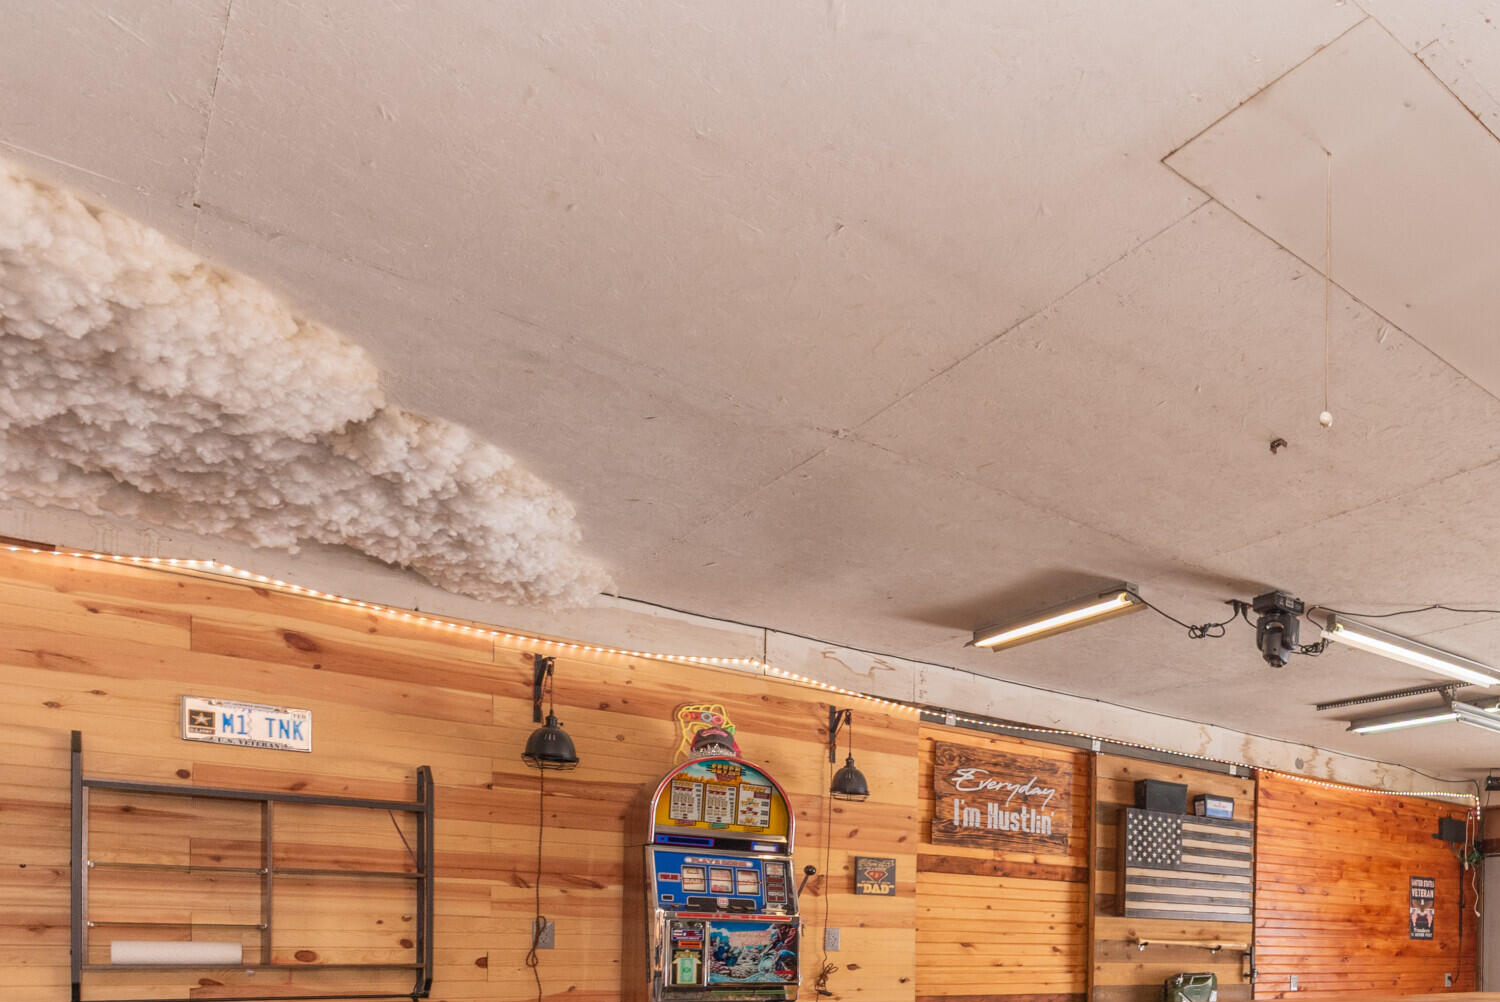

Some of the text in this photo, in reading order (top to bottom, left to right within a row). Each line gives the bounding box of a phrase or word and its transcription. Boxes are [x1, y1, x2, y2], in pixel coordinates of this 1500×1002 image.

[222, 713, 303, 741] M1 TNK
[239, 738, 282, 749] VETERAN
[952, 768, 1056, 812] Everyday
[953, 798, 1055, 835] I'm Hustlin'
[1411, 888, 1434, 898] VETERAN
